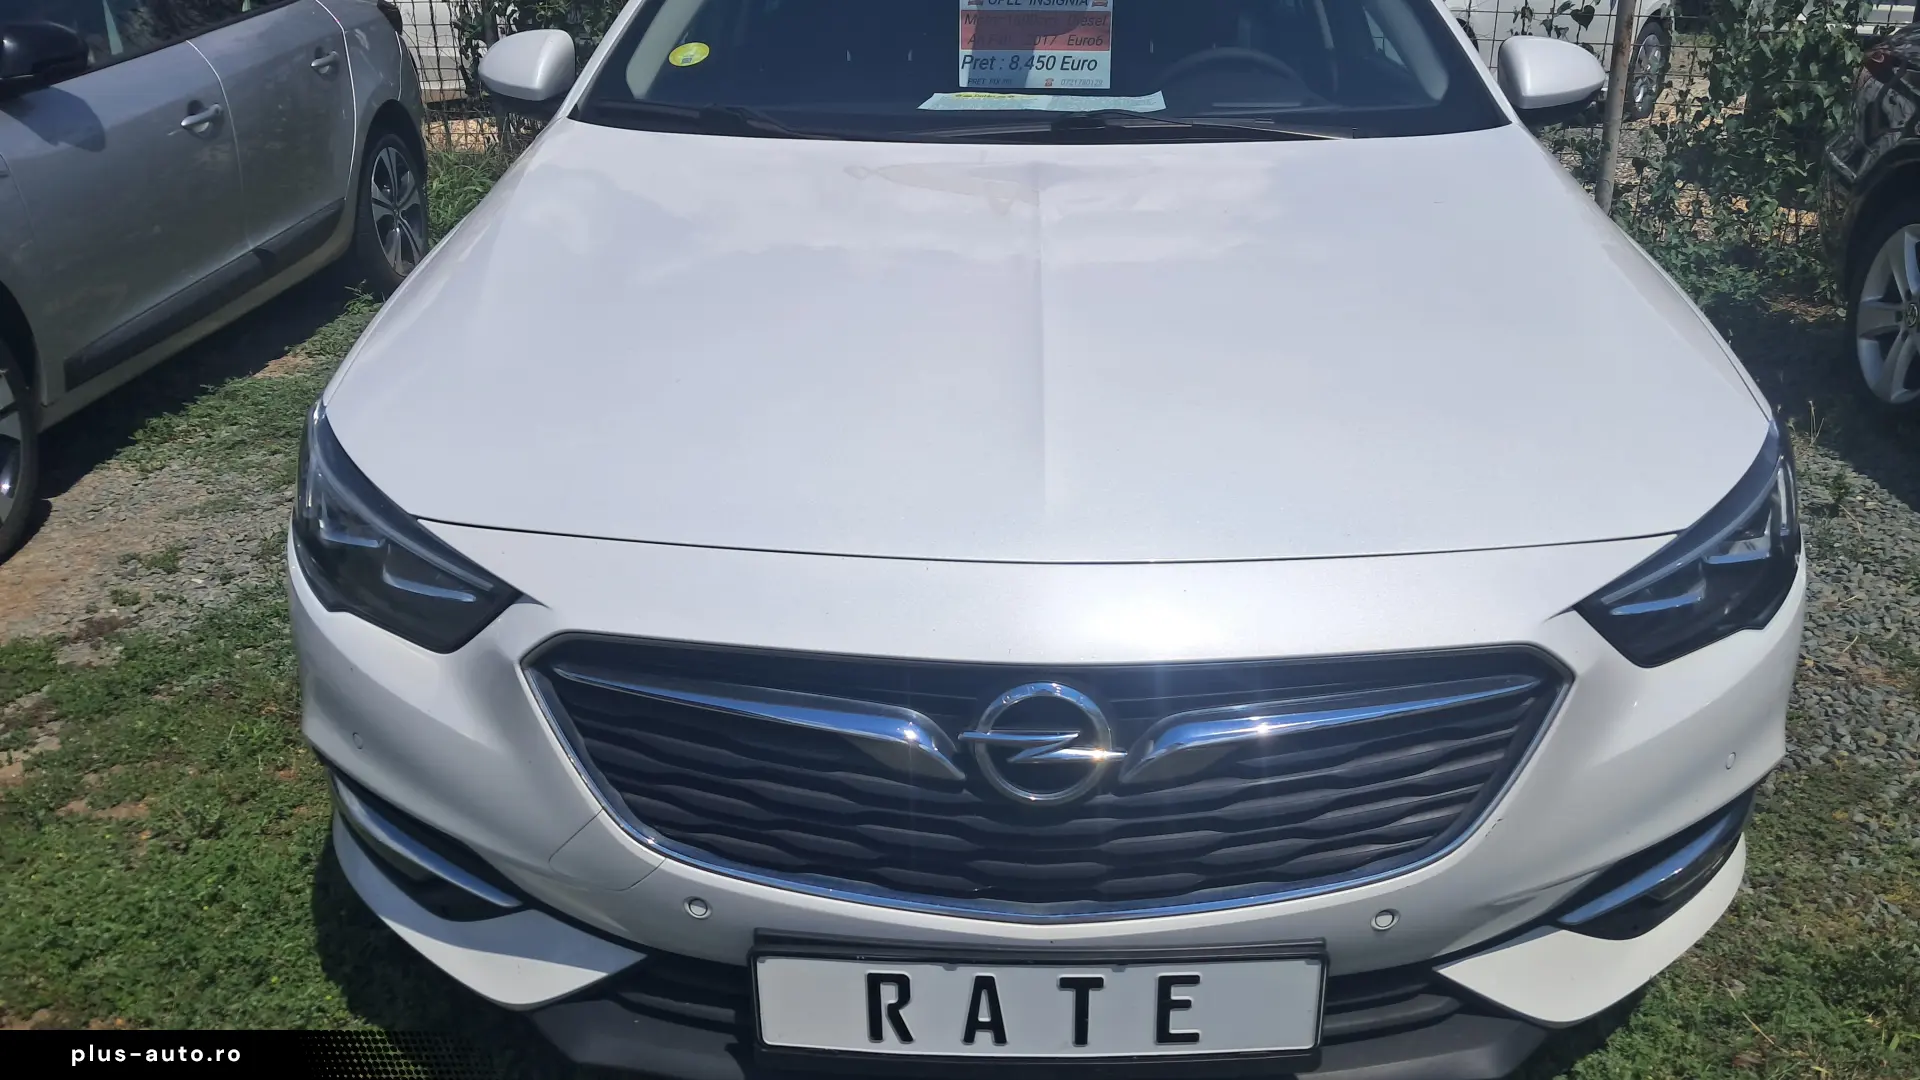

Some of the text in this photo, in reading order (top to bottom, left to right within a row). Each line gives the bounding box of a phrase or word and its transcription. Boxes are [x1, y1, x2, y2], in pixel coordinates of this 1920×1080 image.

[1067, 34, 1104, 46] Euro6
[961, 54, 996, 70] Pret
[1008, 55, 1056, 71] 8.450
[1060, 55, 1098, 71] Euro
[867, 972, 1203, 1045] RATE
